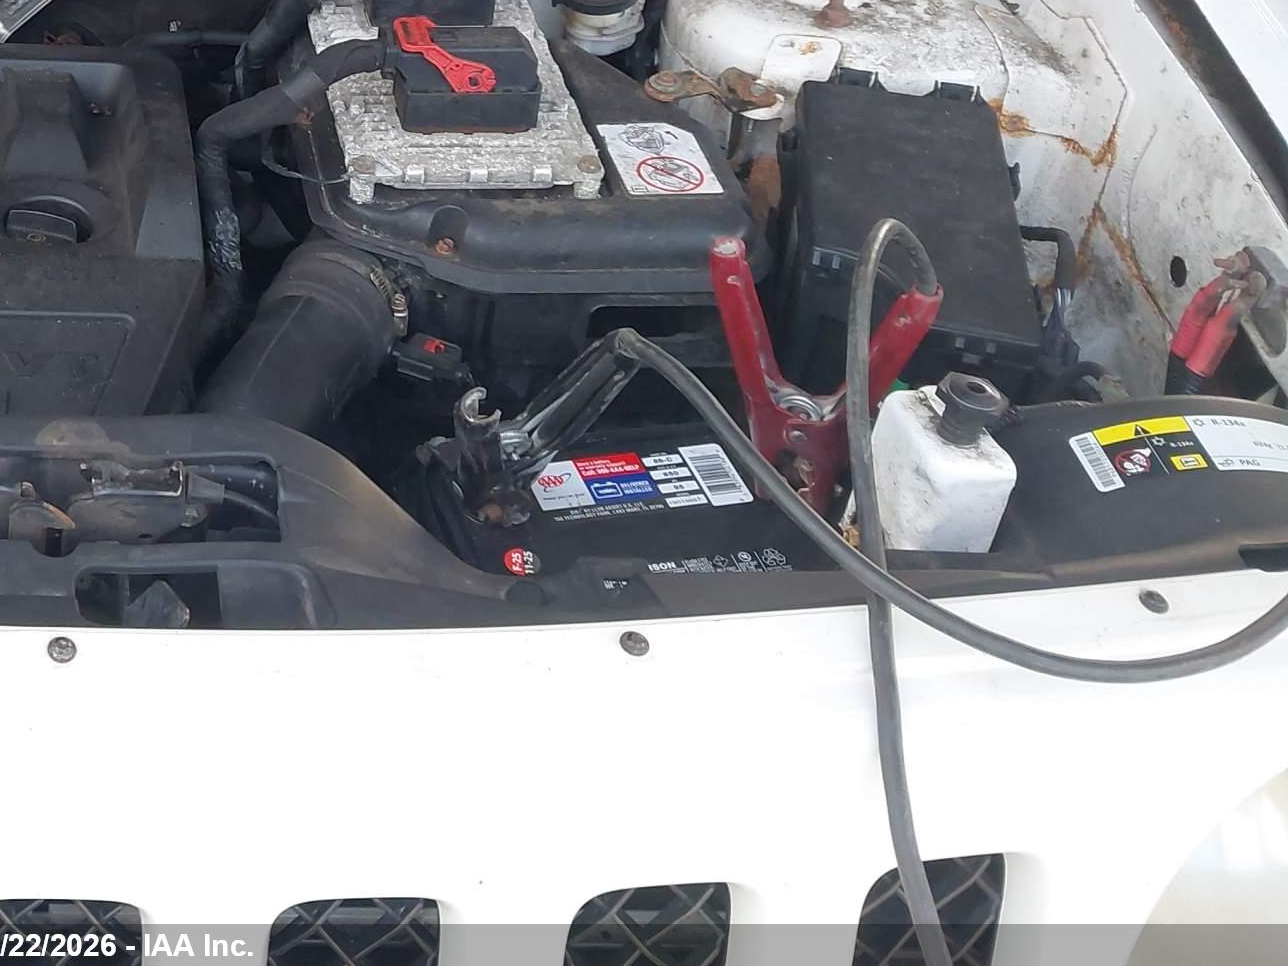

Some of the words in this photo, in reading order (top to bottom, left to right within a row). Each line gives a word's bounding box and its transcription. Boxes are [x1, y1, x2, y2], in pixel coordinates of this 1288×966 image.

[1211, 419, 1246, 427] R-134a
[1238, 458, 1262, 467] PAG
[538, 474, 564, 488] AAA
[511, 552, 522, 571] F-25
[523, 550, 535, 574] 11-25
[647, 561, 676, 571] ISON
